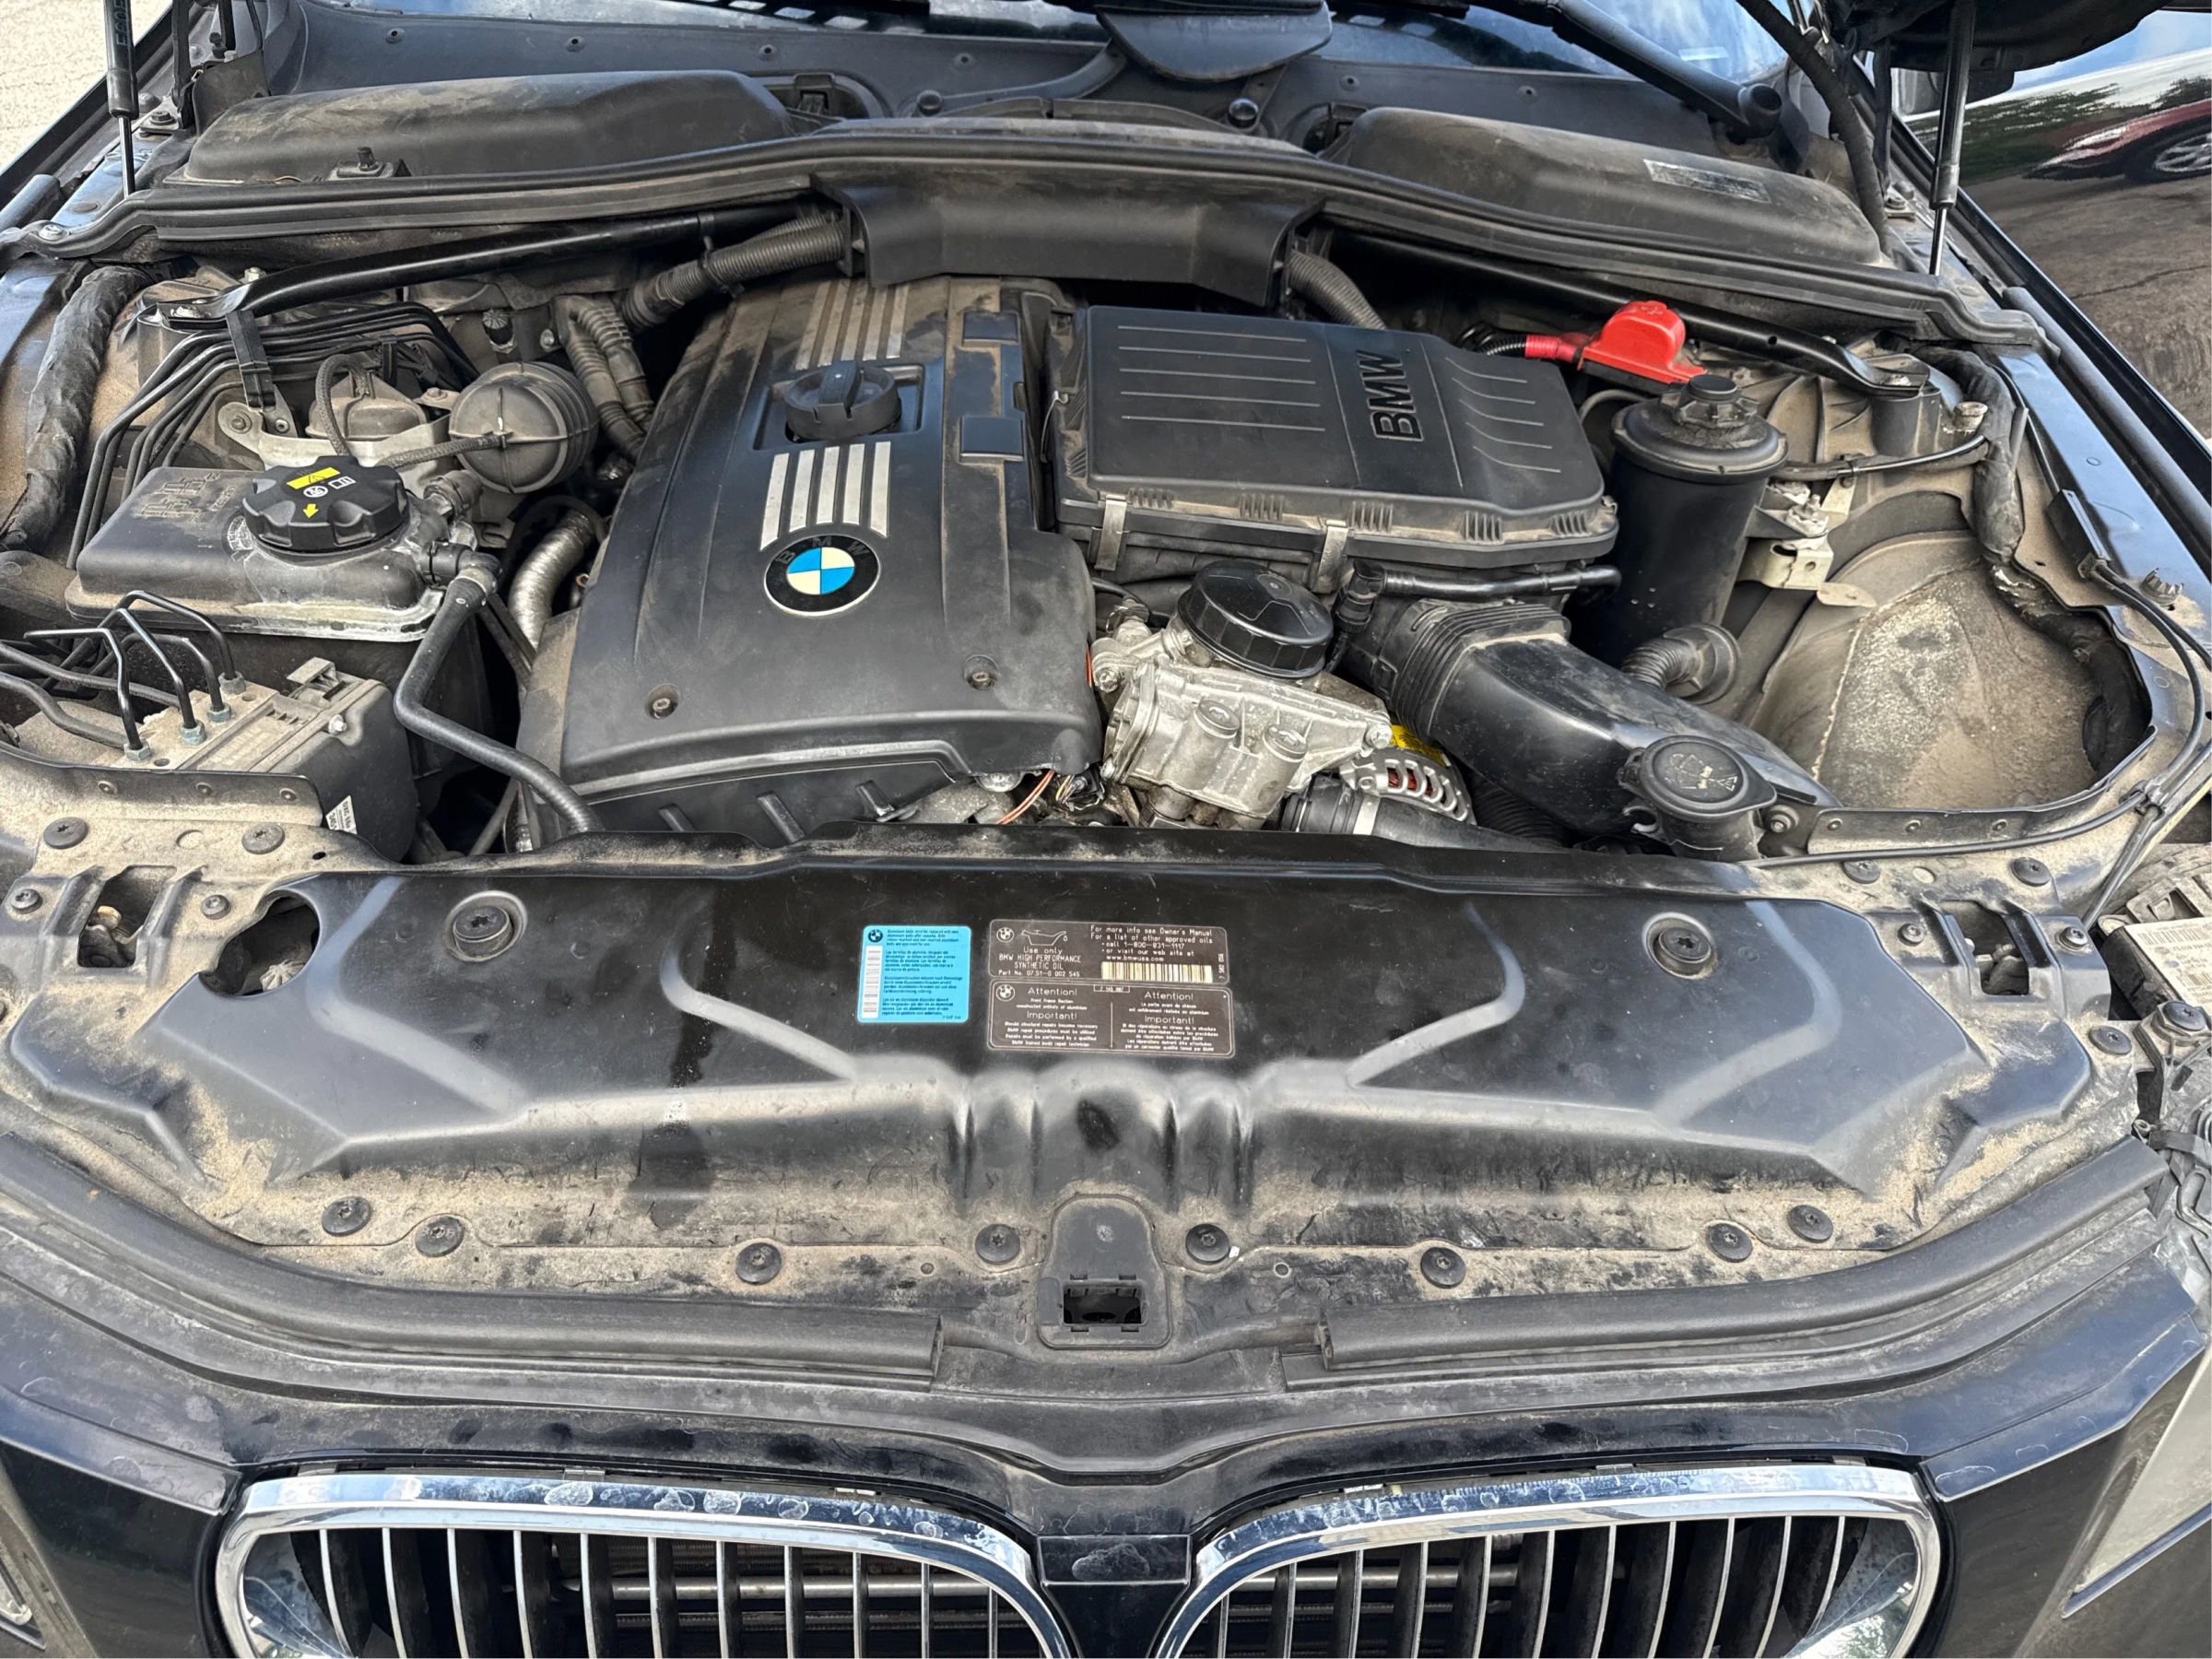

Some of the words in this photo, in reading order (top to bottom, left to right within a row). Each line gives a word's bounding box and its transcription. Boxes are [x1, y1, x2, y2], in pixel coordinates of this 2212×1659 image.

[1357, 349, 1423, 441] BMW
[775, 535, 870, 565] BMW
[1159, 927, 1186, 935] Owner's
[1091, 932, 1102, 940] For
[1023, 946, 1039, 954] Use
[1044, 947, 1063, 955] only
[999, 953, 1014, 961] BMW
[1036, 954, 1082, 963] PERFORMANCE
[1015, 961, 1049, 970] SYNTHETIC
[1053, 962, 1064, 971] OIL
[1028, 987, 1077, 995] Attention!
[1145, 992, 1194, 1001] Attention!
[1027, 1010, 1077, 1019] Important!
[1145, 1016, 1194, 1024] Important!
